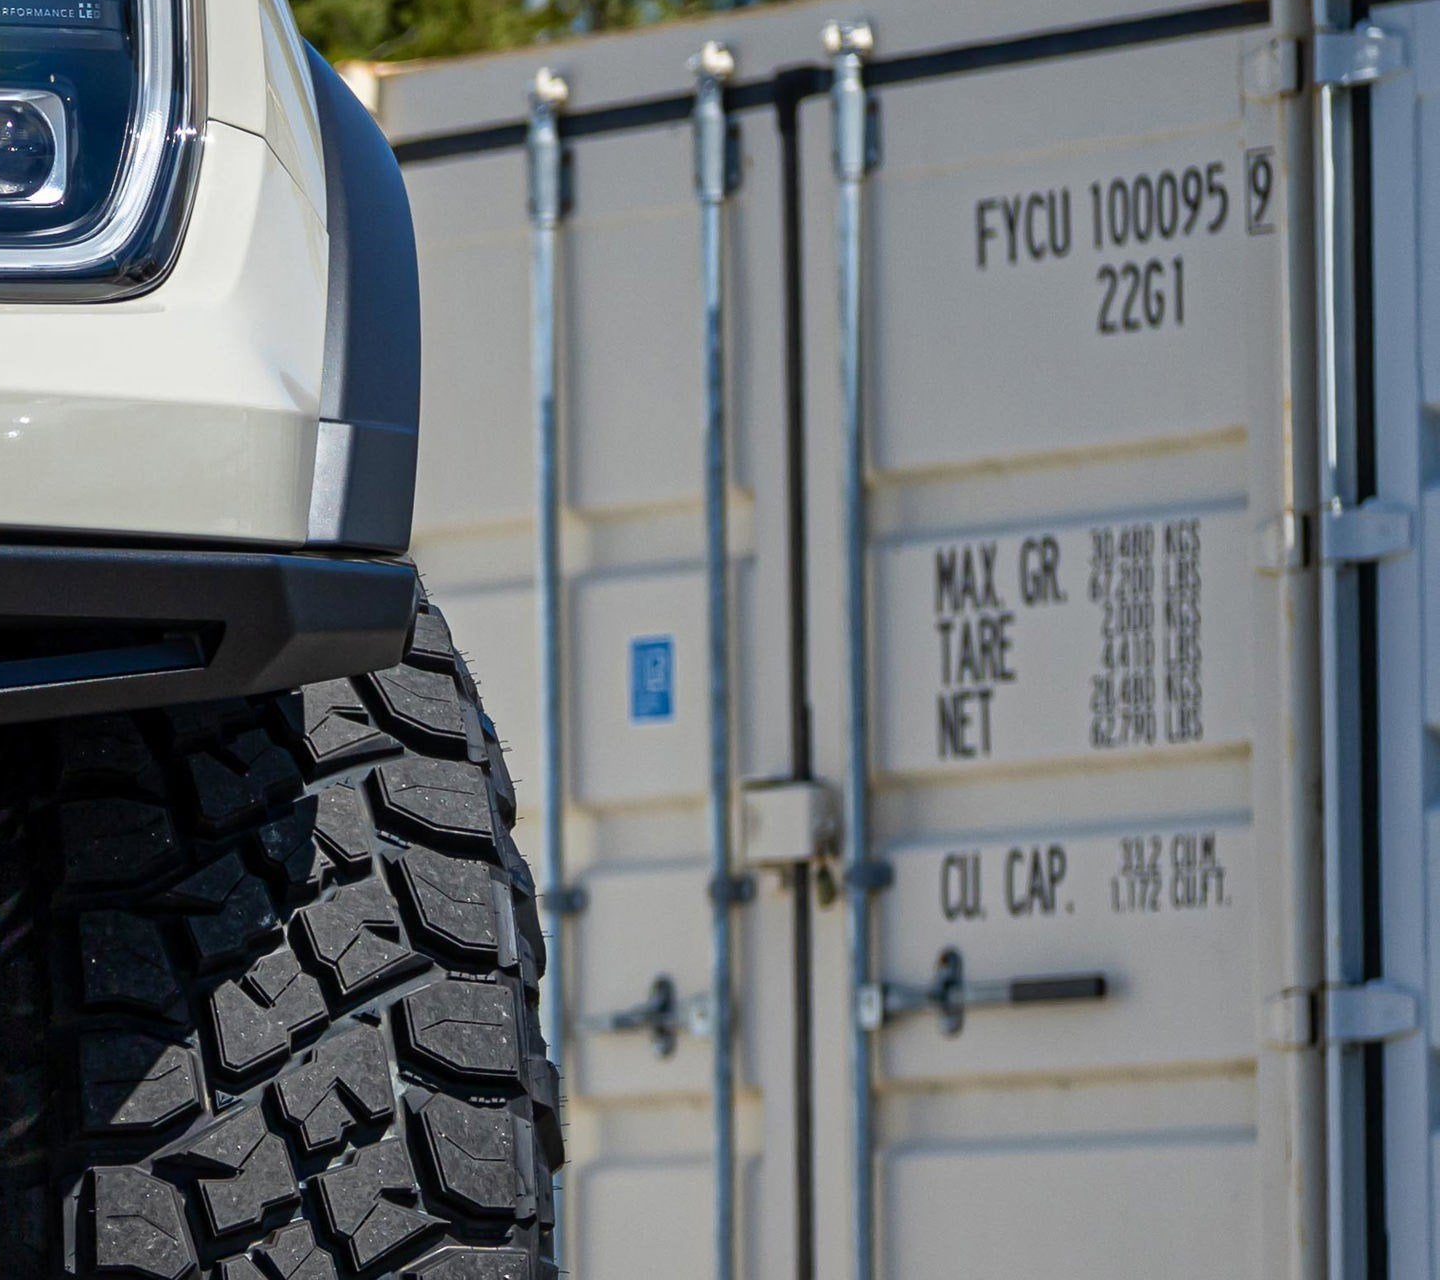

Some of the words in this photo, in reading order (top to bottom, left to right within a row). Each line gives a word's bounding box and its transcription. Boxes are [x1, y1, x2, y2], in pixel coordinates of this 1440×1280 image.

[78, 8, 101, 19] LED
[976, 185, 1071, 269] FYCU
[1089, 160, 1230, 250] 100095
[1251, 153, 1273, 223] 9
[1096, 253, 1185, 333] 22G1
[937, 610, 1017, 686] TARE
[937, 686, 994, 760] NET
[1164, 702, 1203, 741] LBS
[1005, 842, 1075, 915] CAP.
